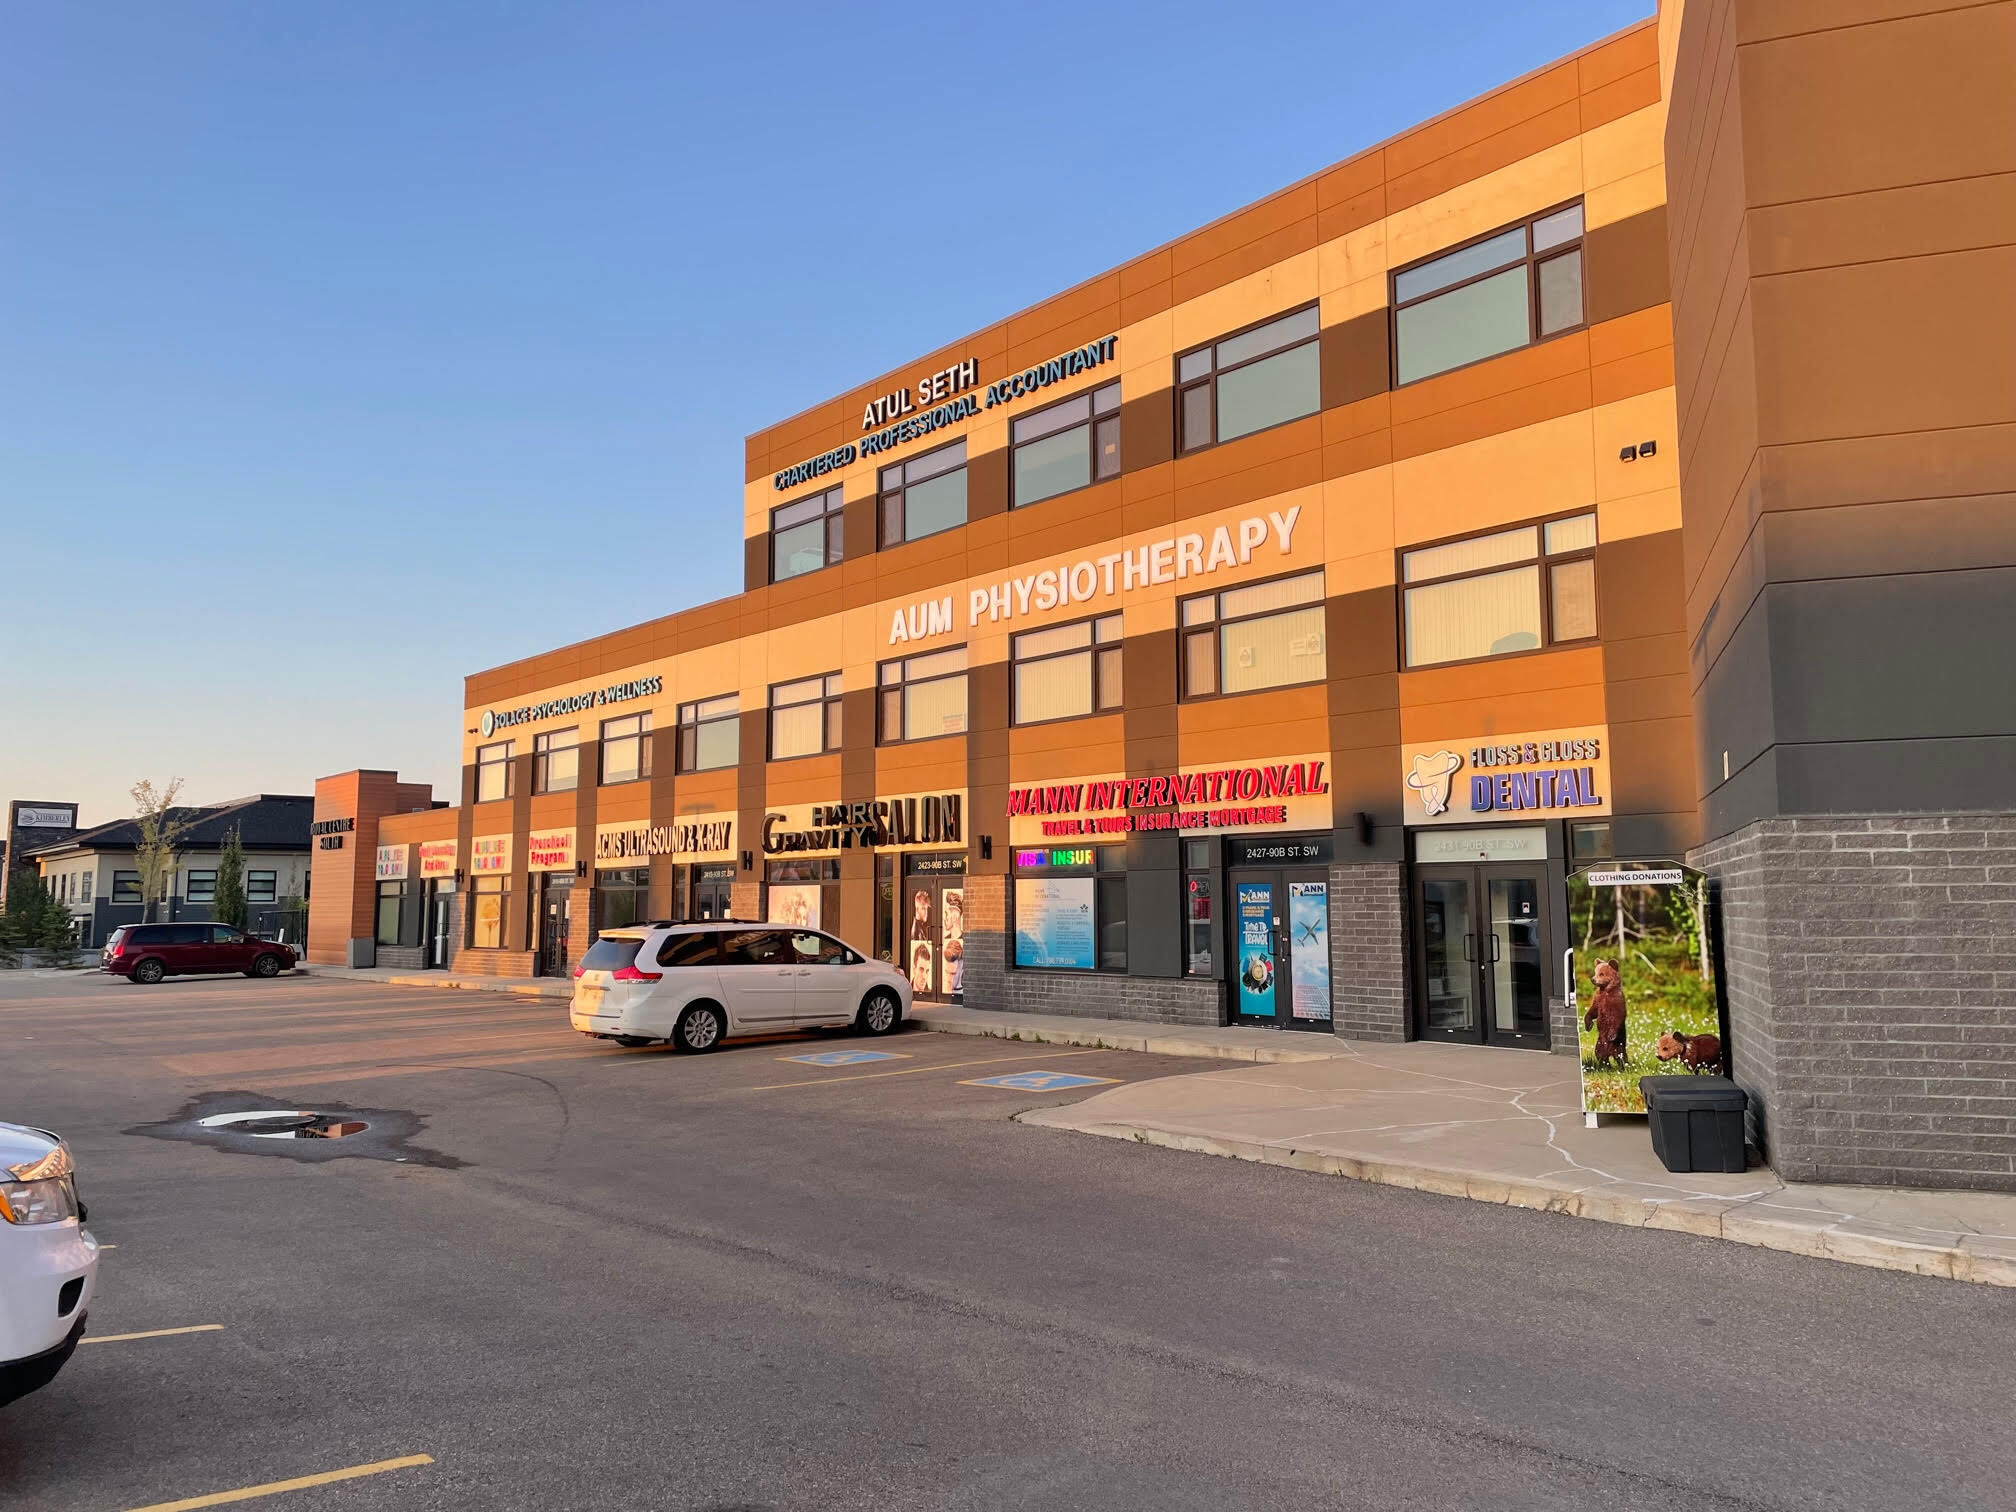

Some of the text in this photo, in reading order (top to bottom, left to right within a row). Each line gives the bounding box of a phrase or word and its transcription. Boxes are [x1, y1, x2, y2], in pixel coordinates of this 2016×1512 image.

[773, 335, 1119, 491] CHARTERED PROFESSIONAL ACCOUNTANT
[862, 357, 979, 429] ATUL SETH
[889, 505, 1302, 645] AUM PHYSIOTHERAPY
[494, 675, 662, 729] SOLACE PSYCHOLOGY & WELLNESS
[1471, 738, 1600, 768] FLOSS & GLOSS
[1006, 761, 1329, 817] MANN INTERNATIONAL
[1471, 766, 1602, 812] DENTAL
[761, 813, 873, 854] GRAVITY
[812, 801, 872, 828] HAIR
[870, 793, 961, 848] SALON
[1041, 806, 1287, 837] TRAVEL & TOURS INSURANCE MORTGAGE
[597, 821, 732, 858] ACMS ULTRASOUND & X-RAY
[1247, 846, 1319, 858] 2427-90B ST. SW
[952, 860, 962, 868] SW
[1589, 871, 1682, 883] CLOTHING DONATIONS
